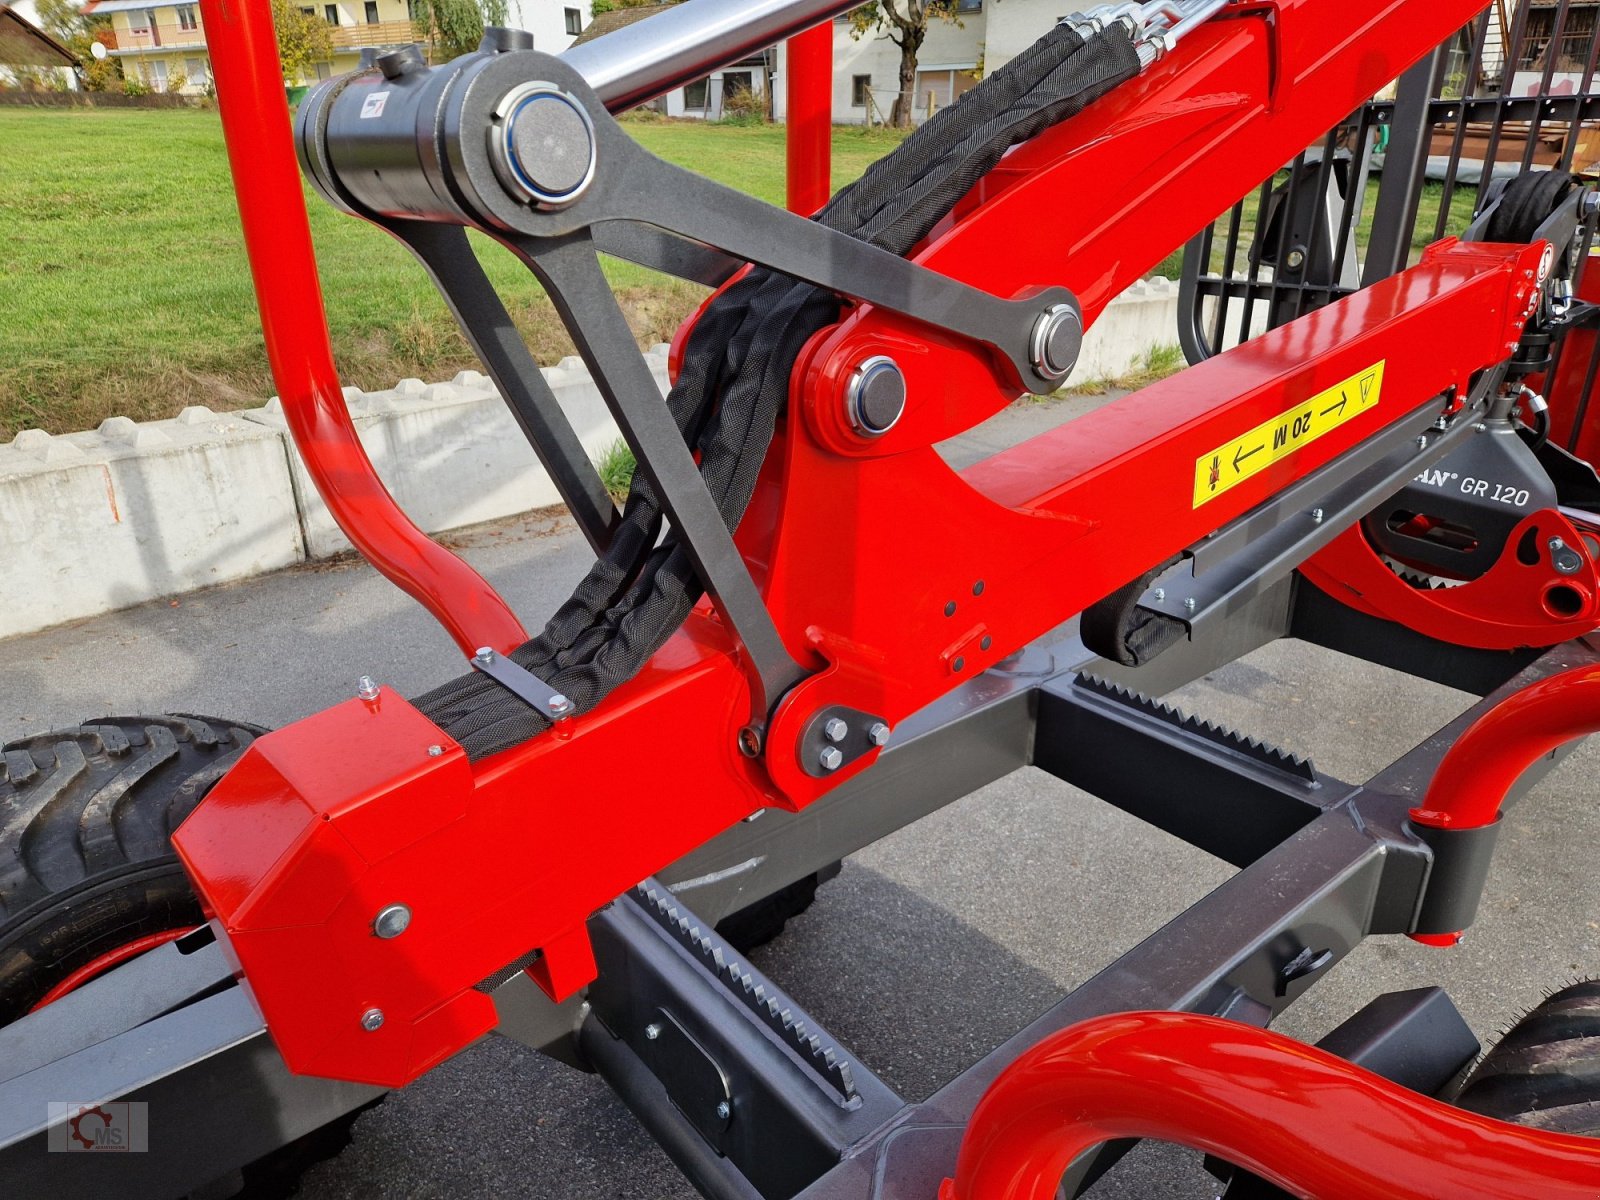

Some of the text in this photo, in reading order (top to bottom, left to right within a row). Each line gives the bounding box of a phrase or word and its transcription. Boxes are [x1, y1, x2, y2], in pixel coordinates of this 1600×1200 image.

[1273, 410, 1312, 450] 20 M
[1460, 477, 1489, 497] GR
[1490, 484, 1530, 507] 120
